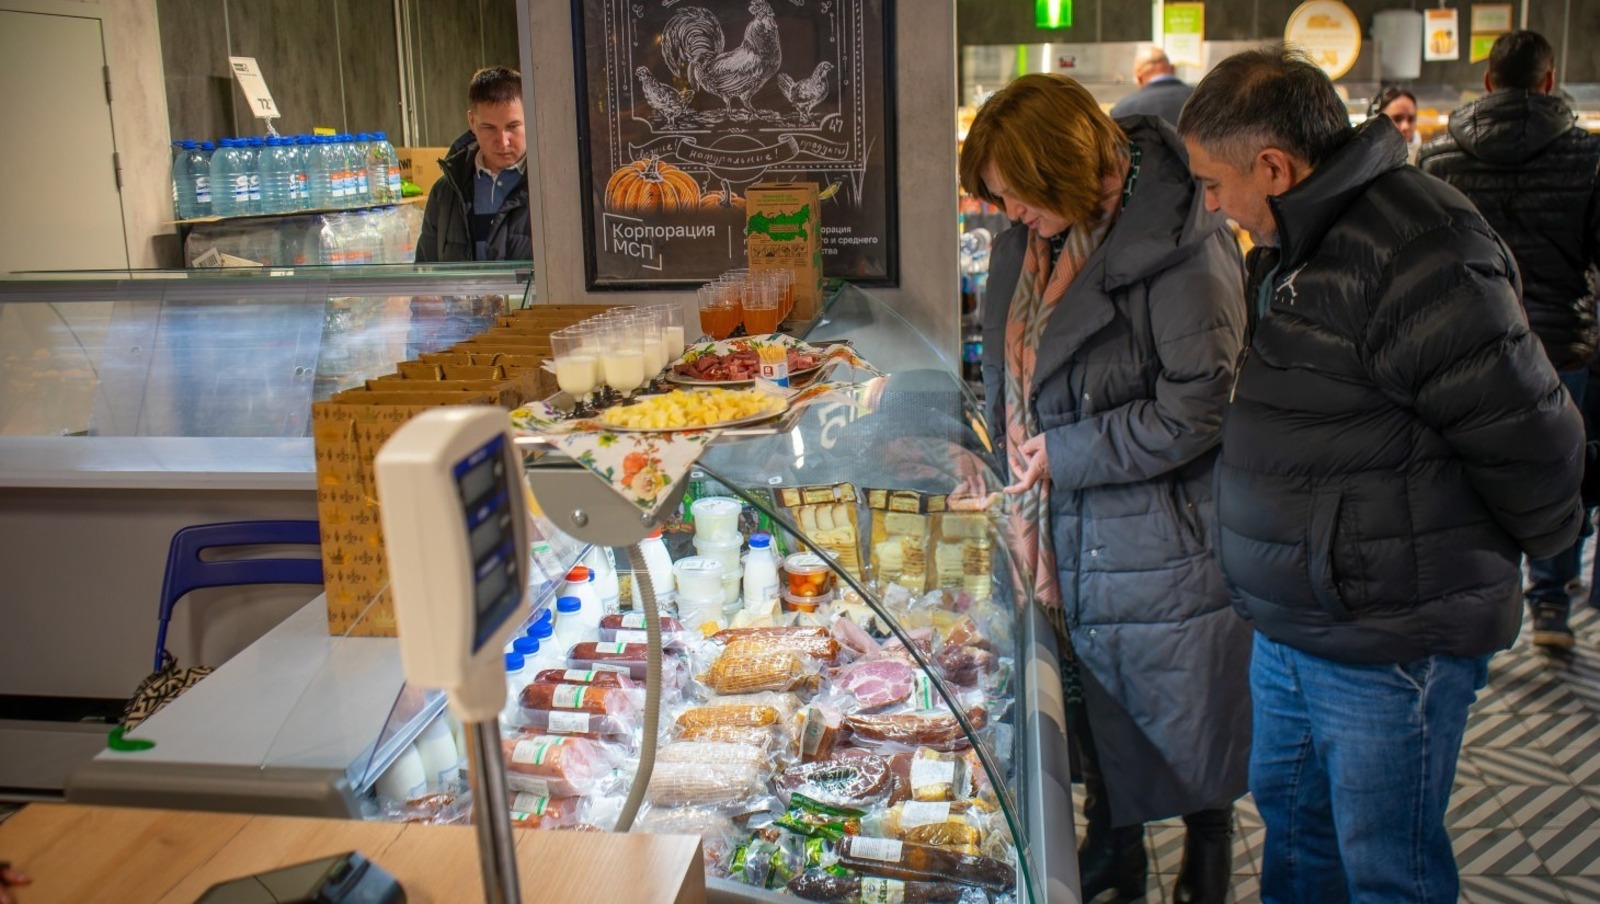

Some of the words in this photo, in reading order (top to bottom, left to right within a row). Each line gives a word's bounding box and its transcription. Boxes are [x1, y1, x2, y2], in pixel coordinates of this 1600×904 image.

[828, 117, 844, 134] 47
[612, 223, 716, 242] Корпорация
[837, 236, 878, 246] среднего
[613, 238, 654, 260] МСП
